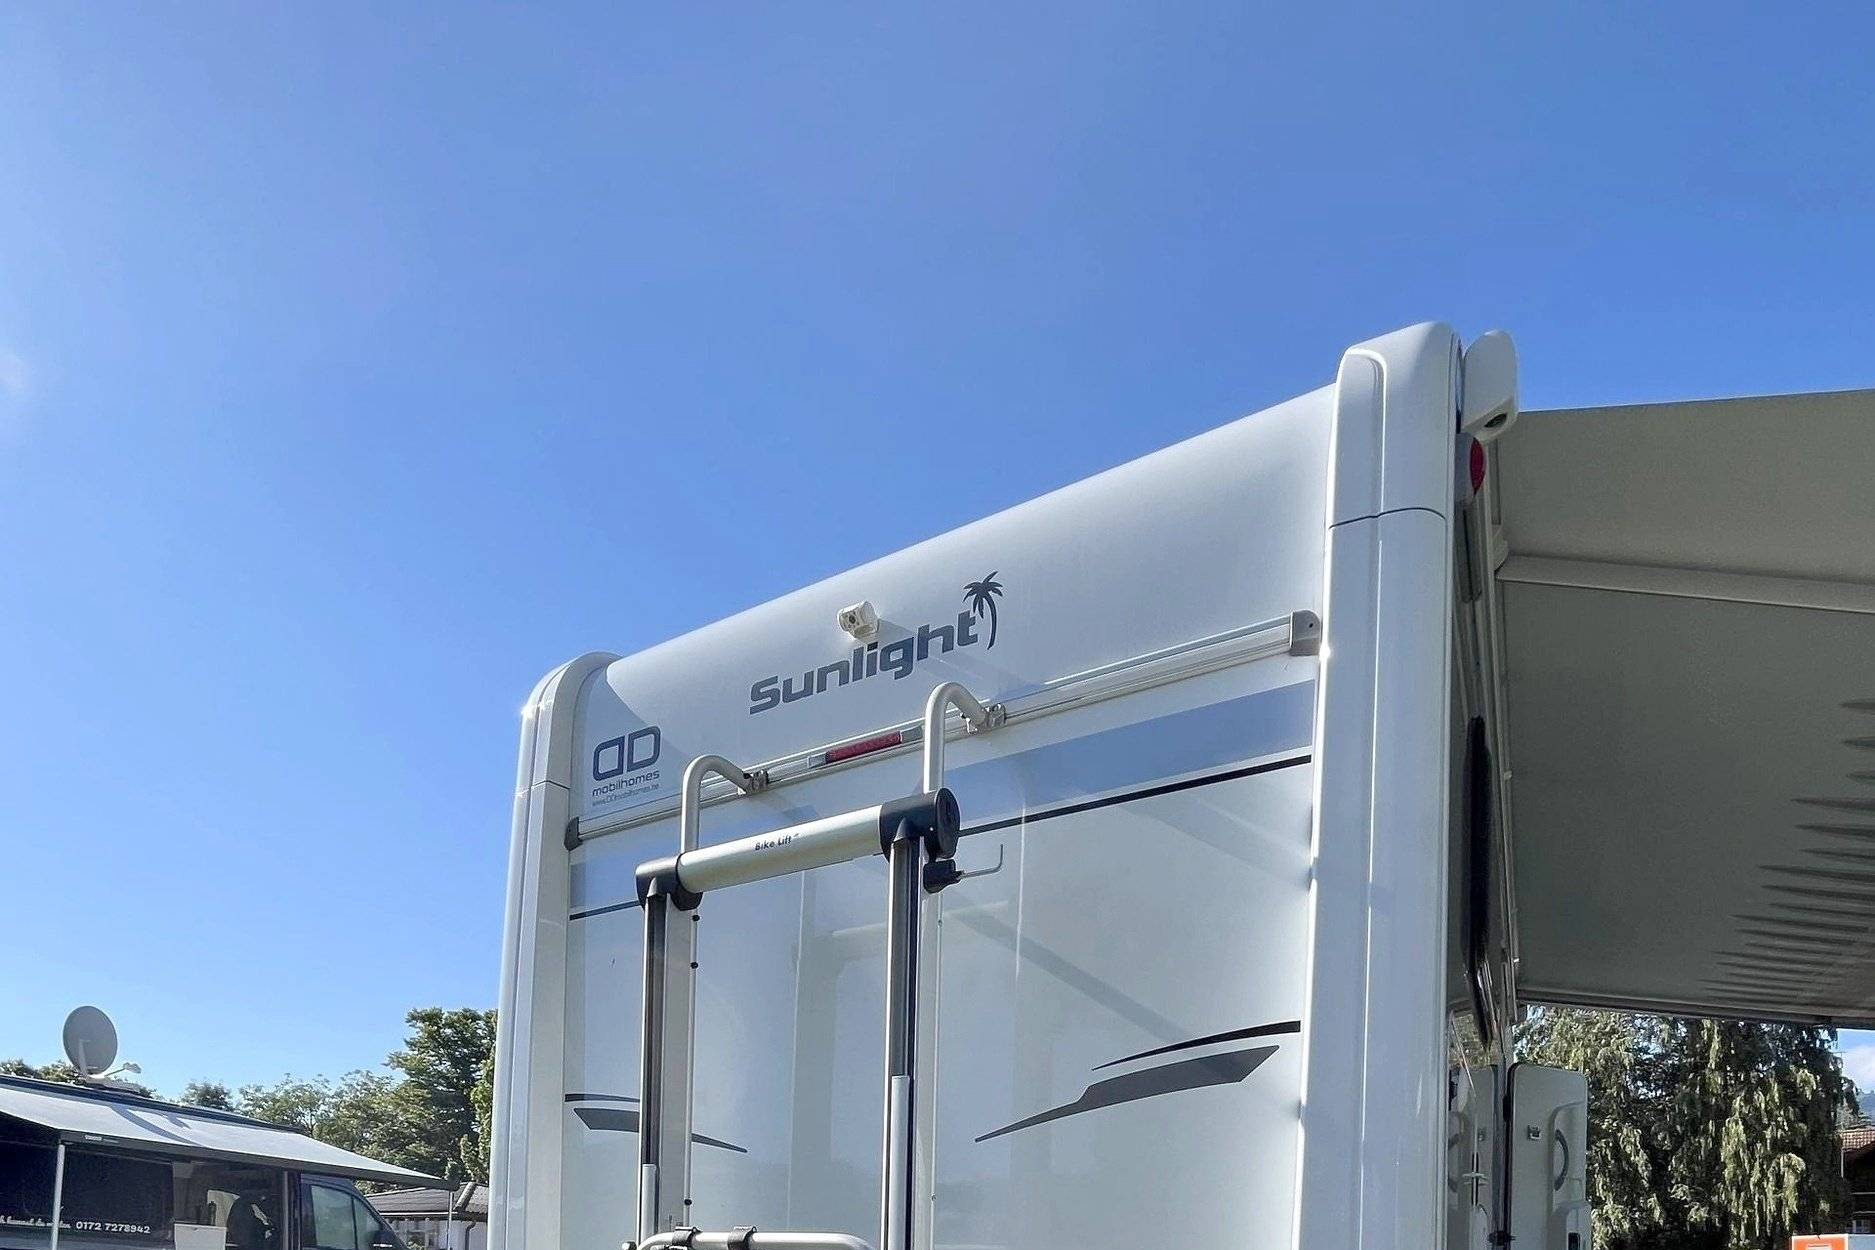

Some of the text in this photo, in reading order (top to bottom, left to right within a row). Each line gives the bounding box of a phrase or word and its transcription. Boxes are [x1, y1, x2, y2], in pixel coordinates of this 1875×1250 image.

[749, 609, 979, 715] Sunlight
[592, 770, 660, 797] mobilhomes
[755, 836, 792, 850] Bike Lift
[76, 1221, 102, 1231] 0172
